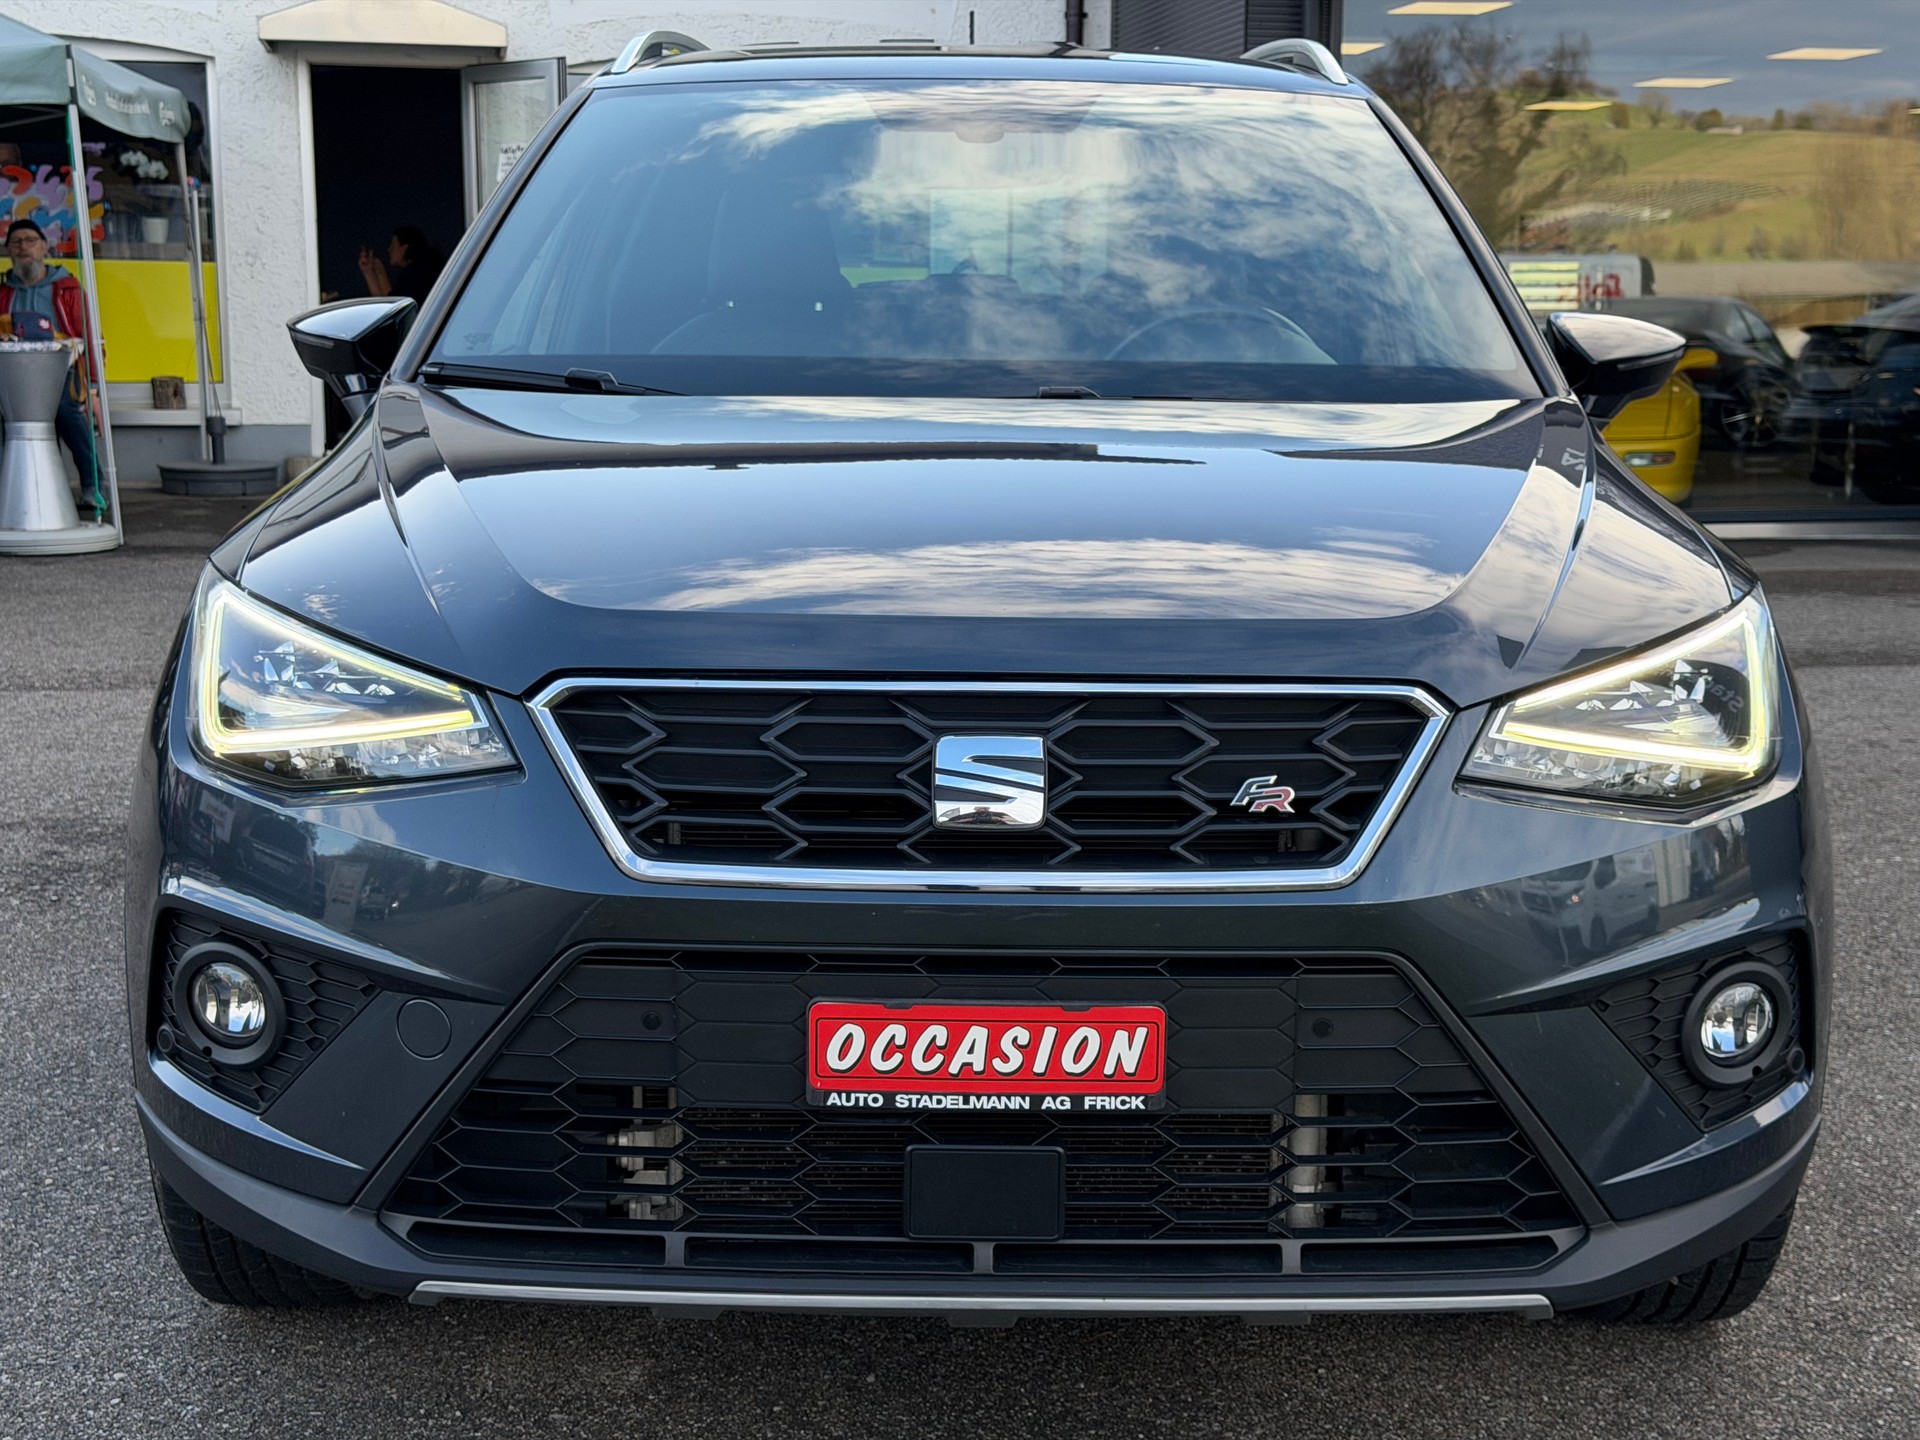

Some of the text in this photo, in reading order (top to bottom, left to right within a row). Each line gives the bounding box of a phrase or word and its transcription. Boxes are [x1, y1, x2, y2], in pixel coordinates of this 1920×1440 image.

[1230, 775, 1295, 813] FR
[826, 1023, 1148, 1077] OCCASION
[827, 1092, 1145, 1110] AUTO STADELMANN AG FRICK
